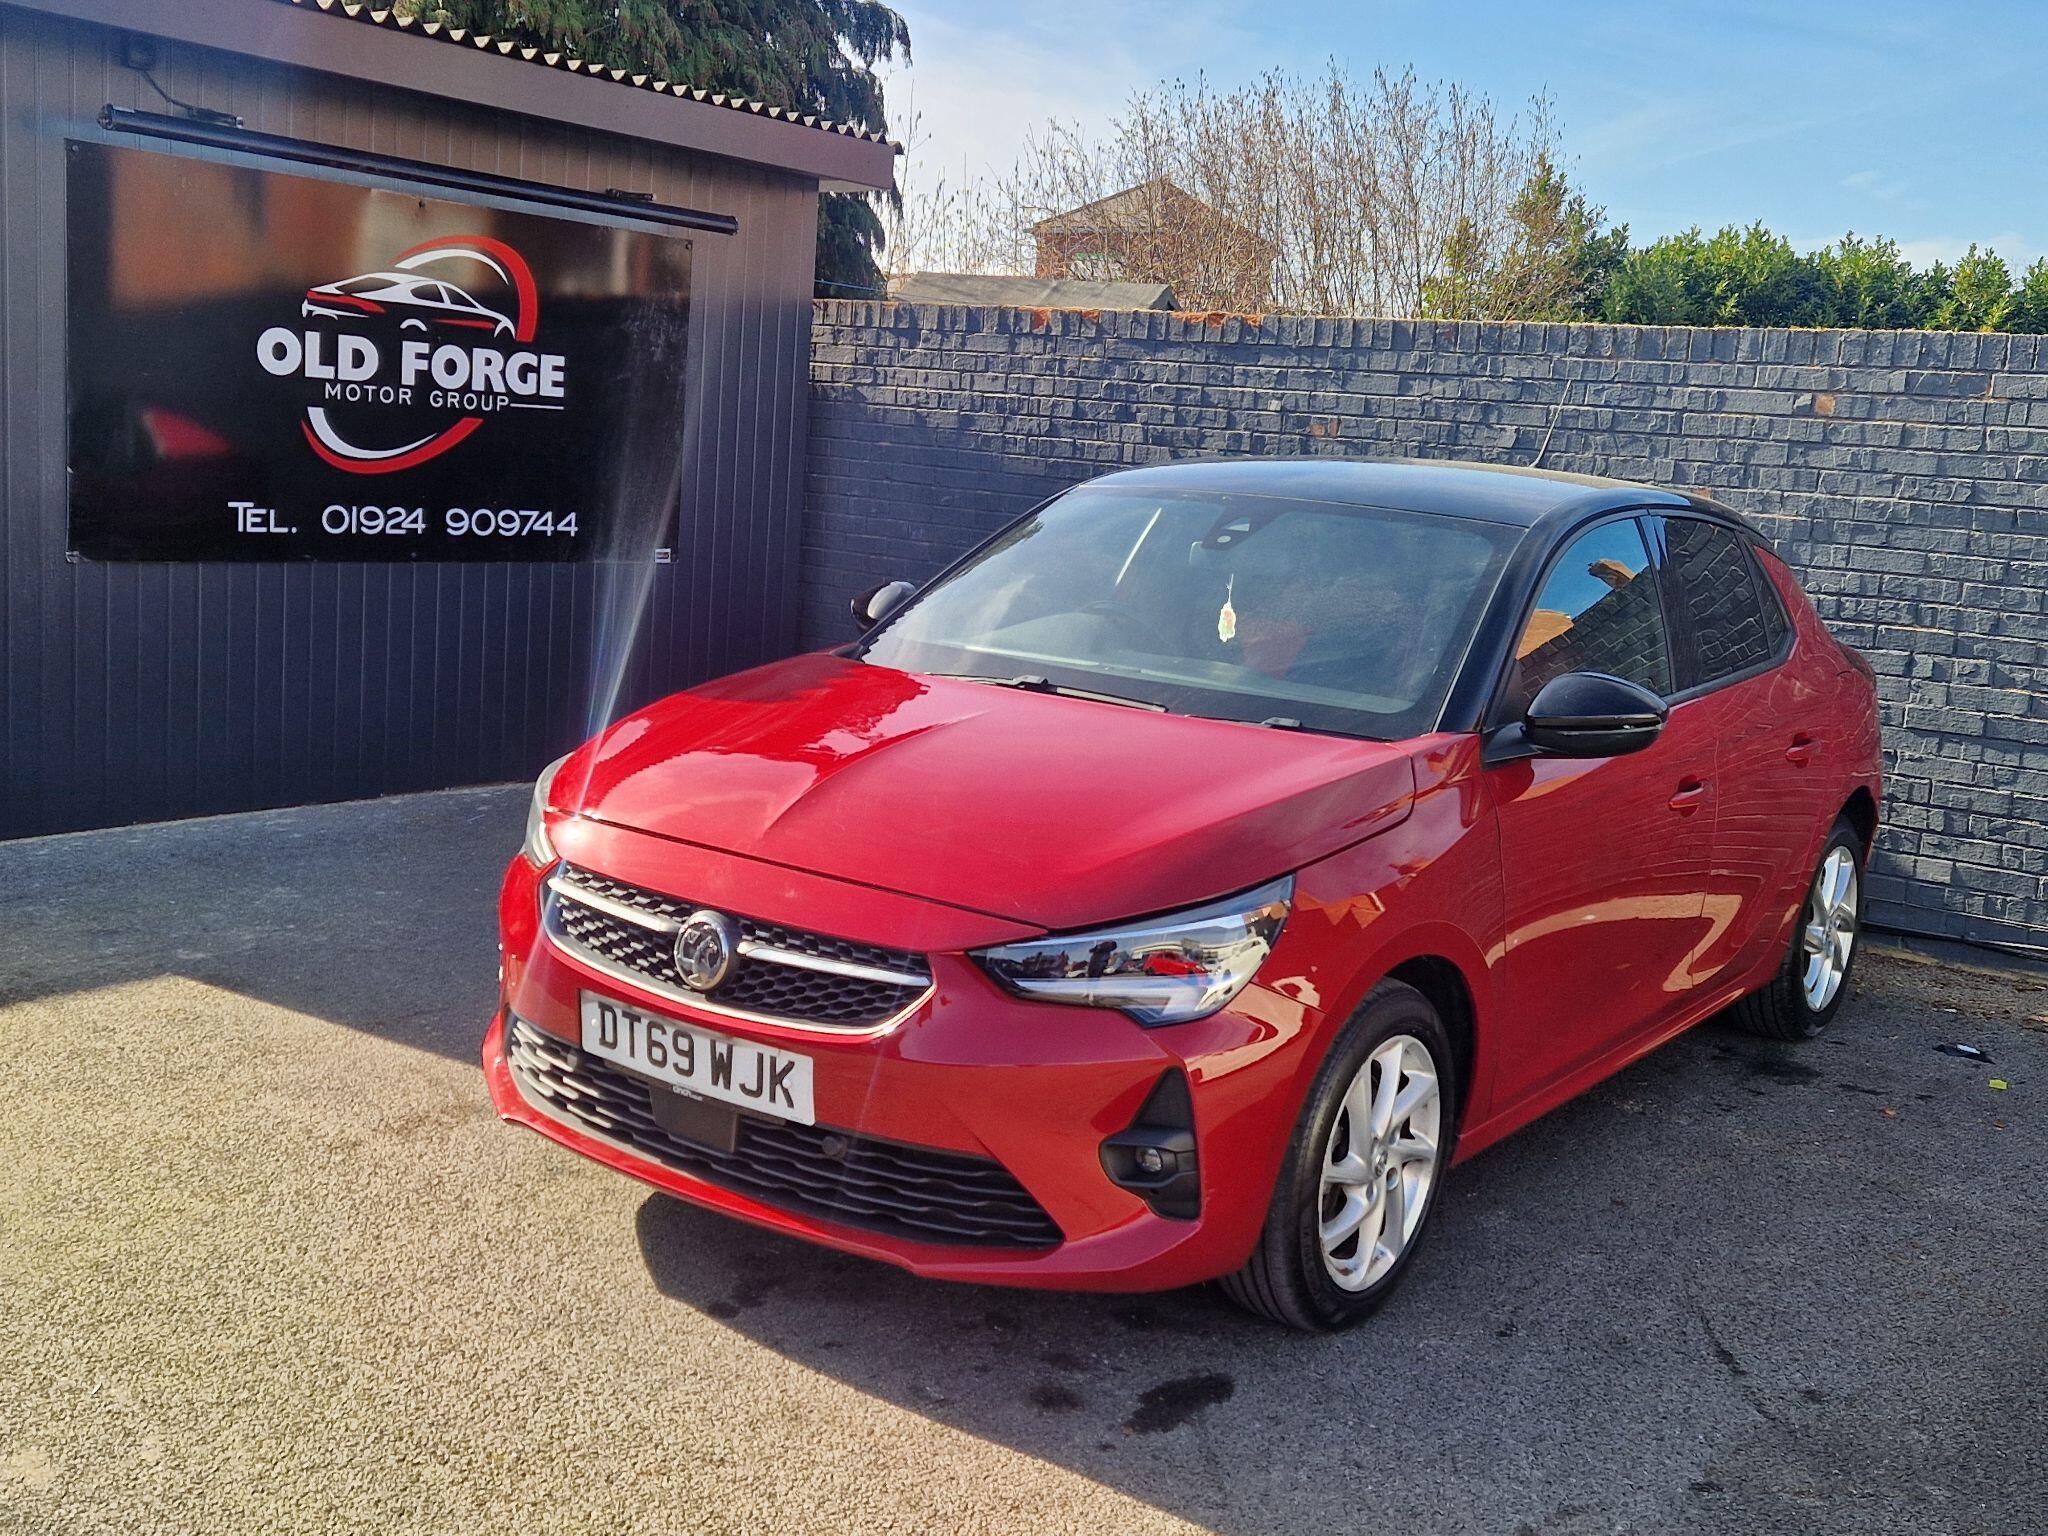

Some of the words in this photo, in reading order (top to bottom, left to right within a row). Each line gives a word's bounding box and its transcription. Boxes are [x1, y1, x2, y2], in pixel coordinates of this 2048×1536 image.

[256, 327, 379, 381] OLD
[402, 341, 565, 397] FORGE
[325, 383, 411, 405] MOTOR
[430, 390, 510, 411] GROUP
[228, 501, 297, 534] TEL.
[322, 504, 426, 535] 01924
[446, 508, 578, 537] 909744
[598, 1002, 695, 1078] DT69
[710, 1039, 795, 1109] WJK
